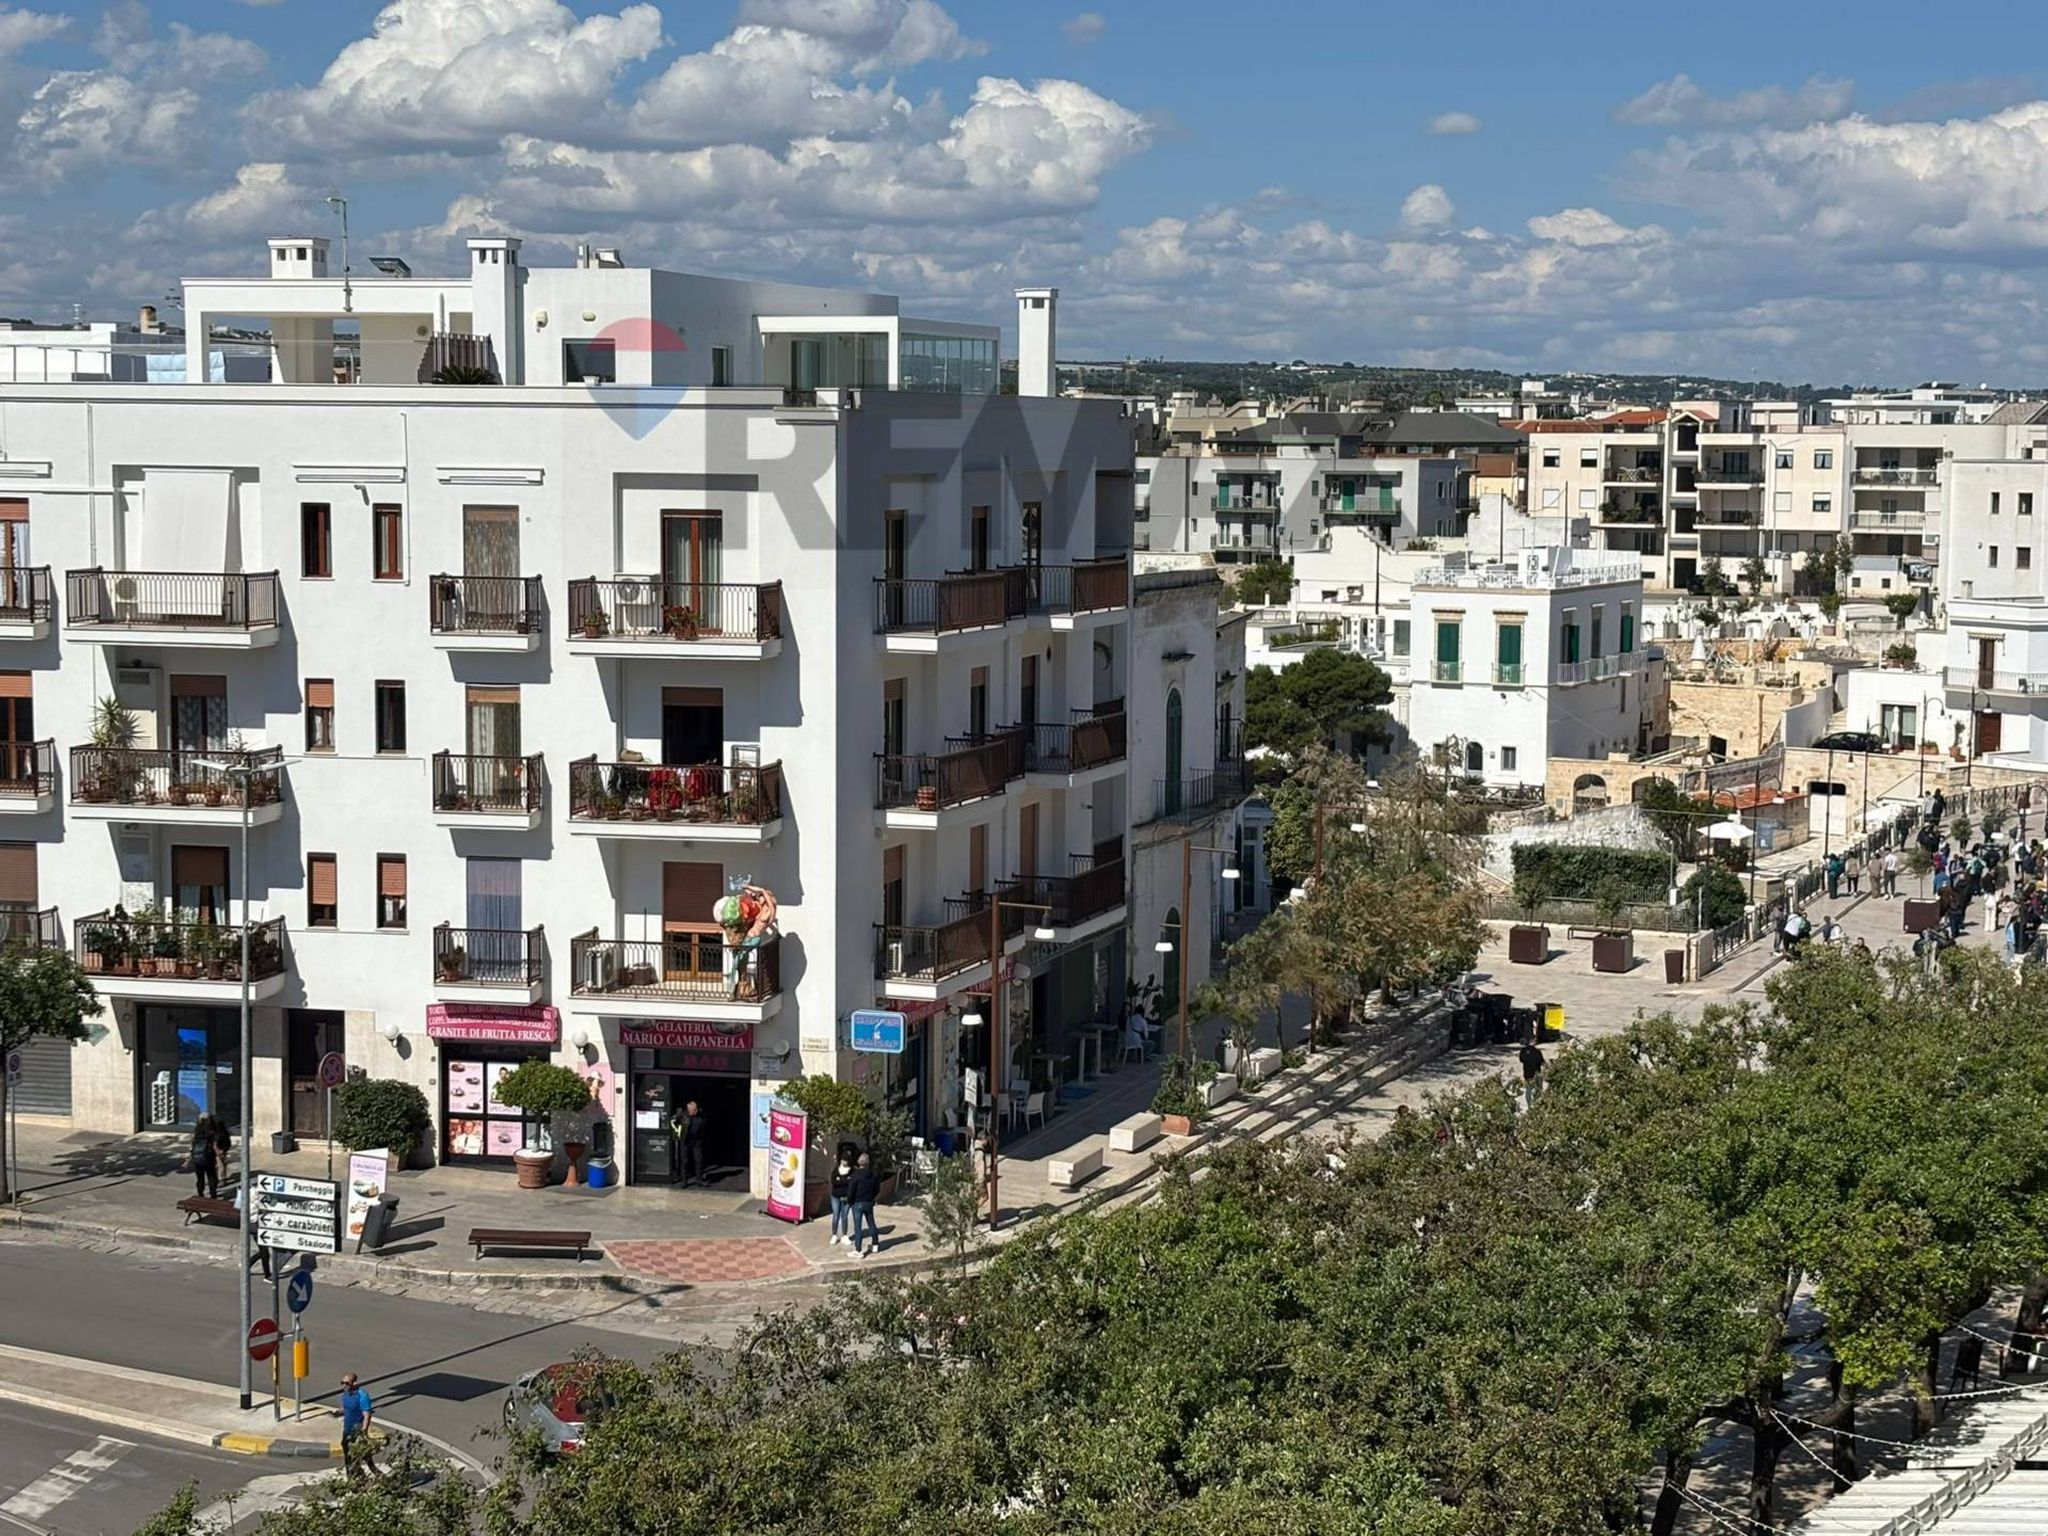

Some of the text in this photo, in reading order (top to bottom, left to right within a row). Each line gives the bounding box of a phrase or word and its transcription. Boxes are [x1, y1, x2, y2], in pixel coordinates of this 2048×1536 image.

[428, 1026, 551, 1042] GRANITE DI FRUTTA FRESCA
[655, 1021, 713, 1034] GELATERIA
[622, 1032, 745, 1049] MARIO CAMPANELLA
[275, 1179, 333, 1195] P Parcheggio
[286, 1201, 334, 1214] MUNICIPIO
[297, 1237, 334, 1250] Stazione
